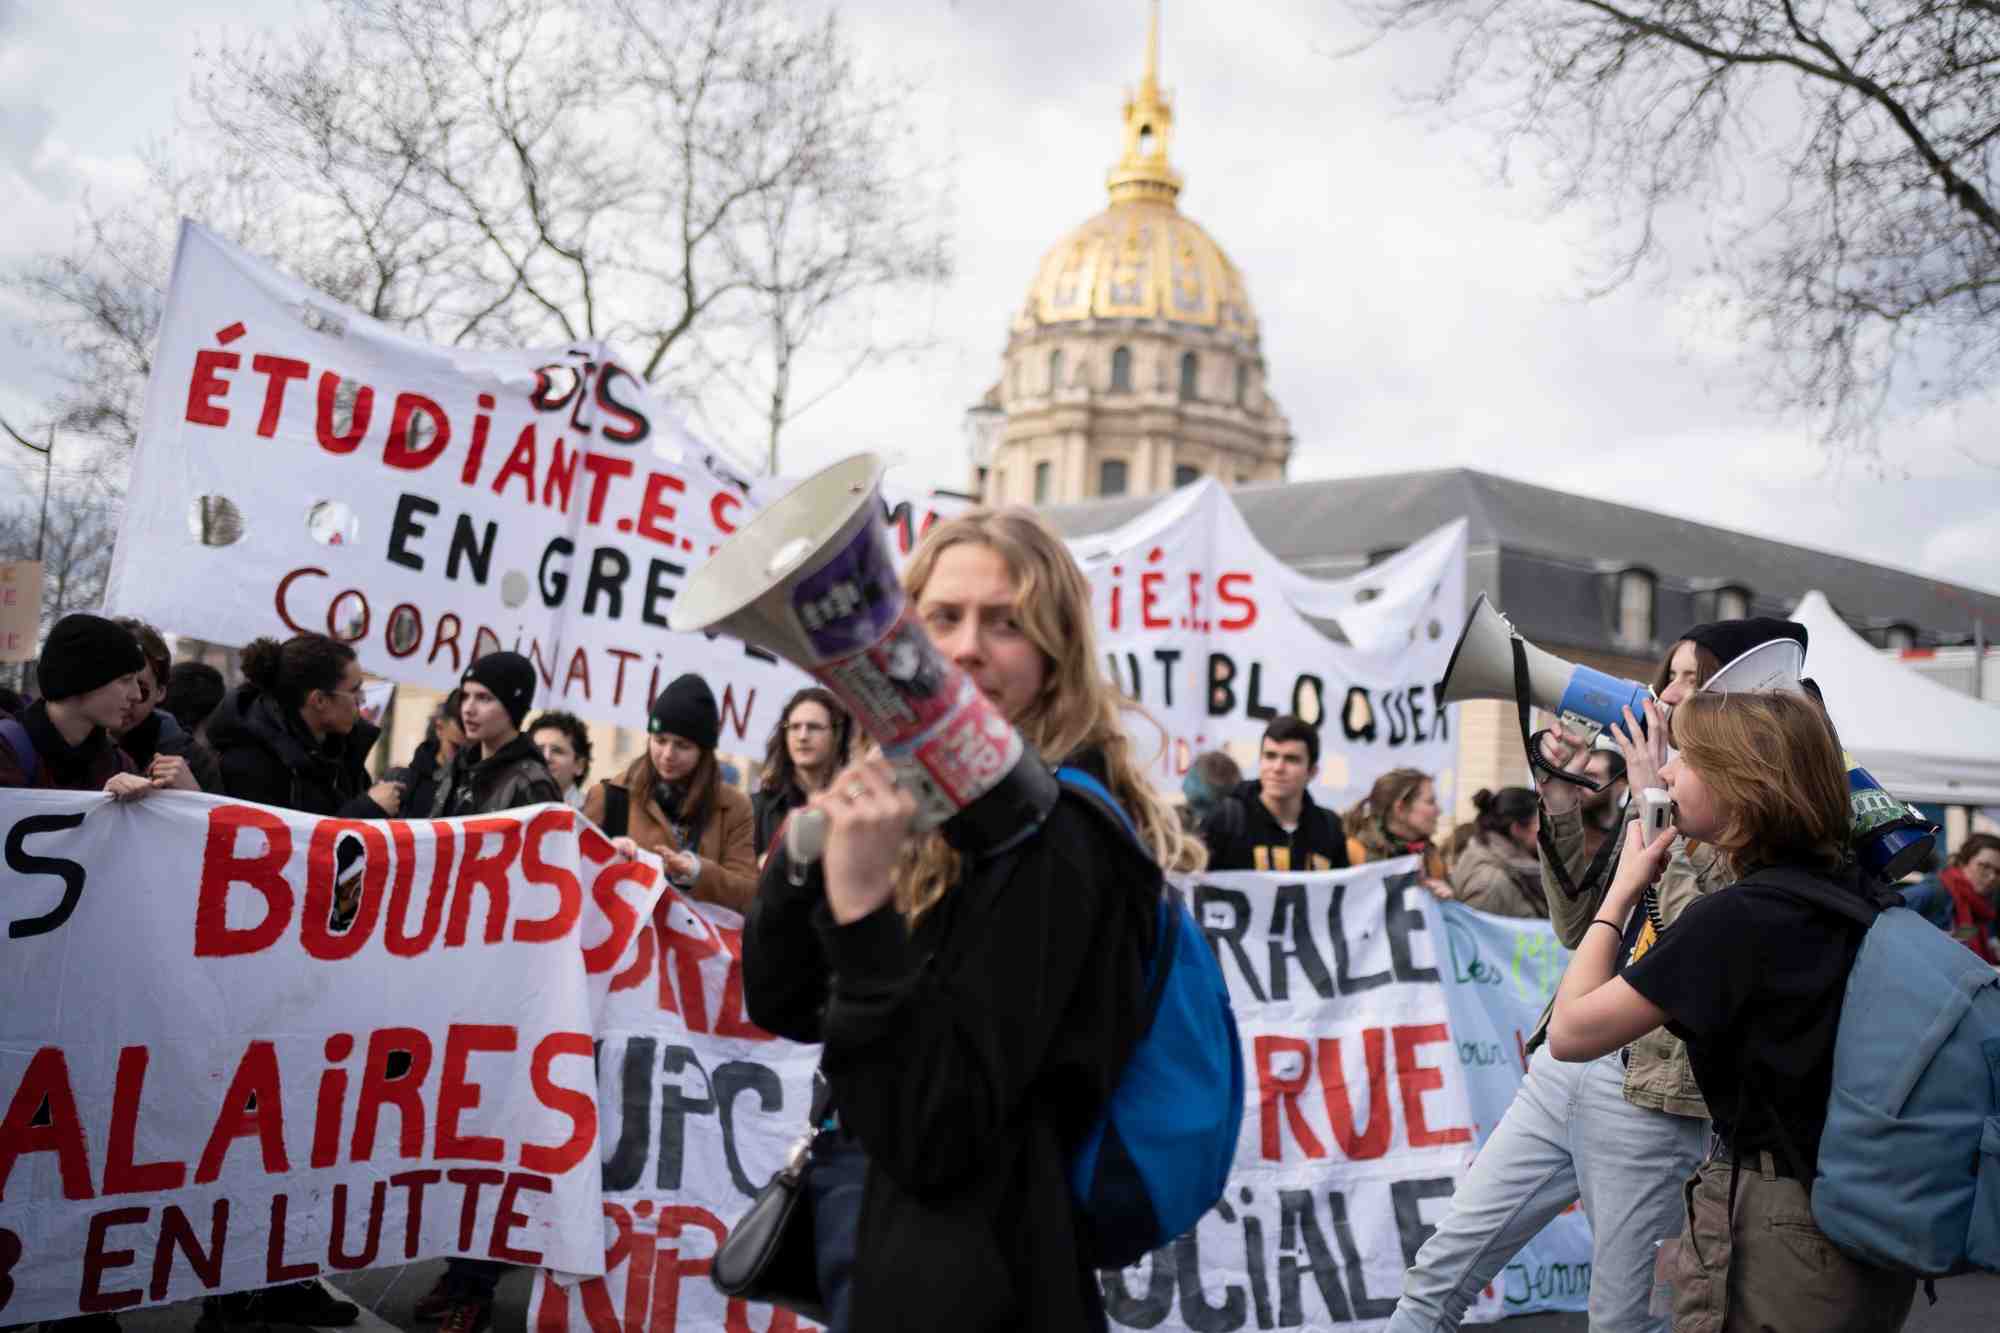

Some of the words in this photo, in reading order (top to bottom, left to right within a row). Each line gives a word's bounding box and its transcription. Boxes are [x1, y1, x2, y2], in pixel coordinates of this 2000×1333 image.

[387, 494, 498, 586] EN
[275, 567, 757, 740] COORDiNATiN
[1254, 1023, 1474, 1162] RUE
[78, 1198, 229, 1313] EN
[266, 1168, 554, 1284] LUTTE
